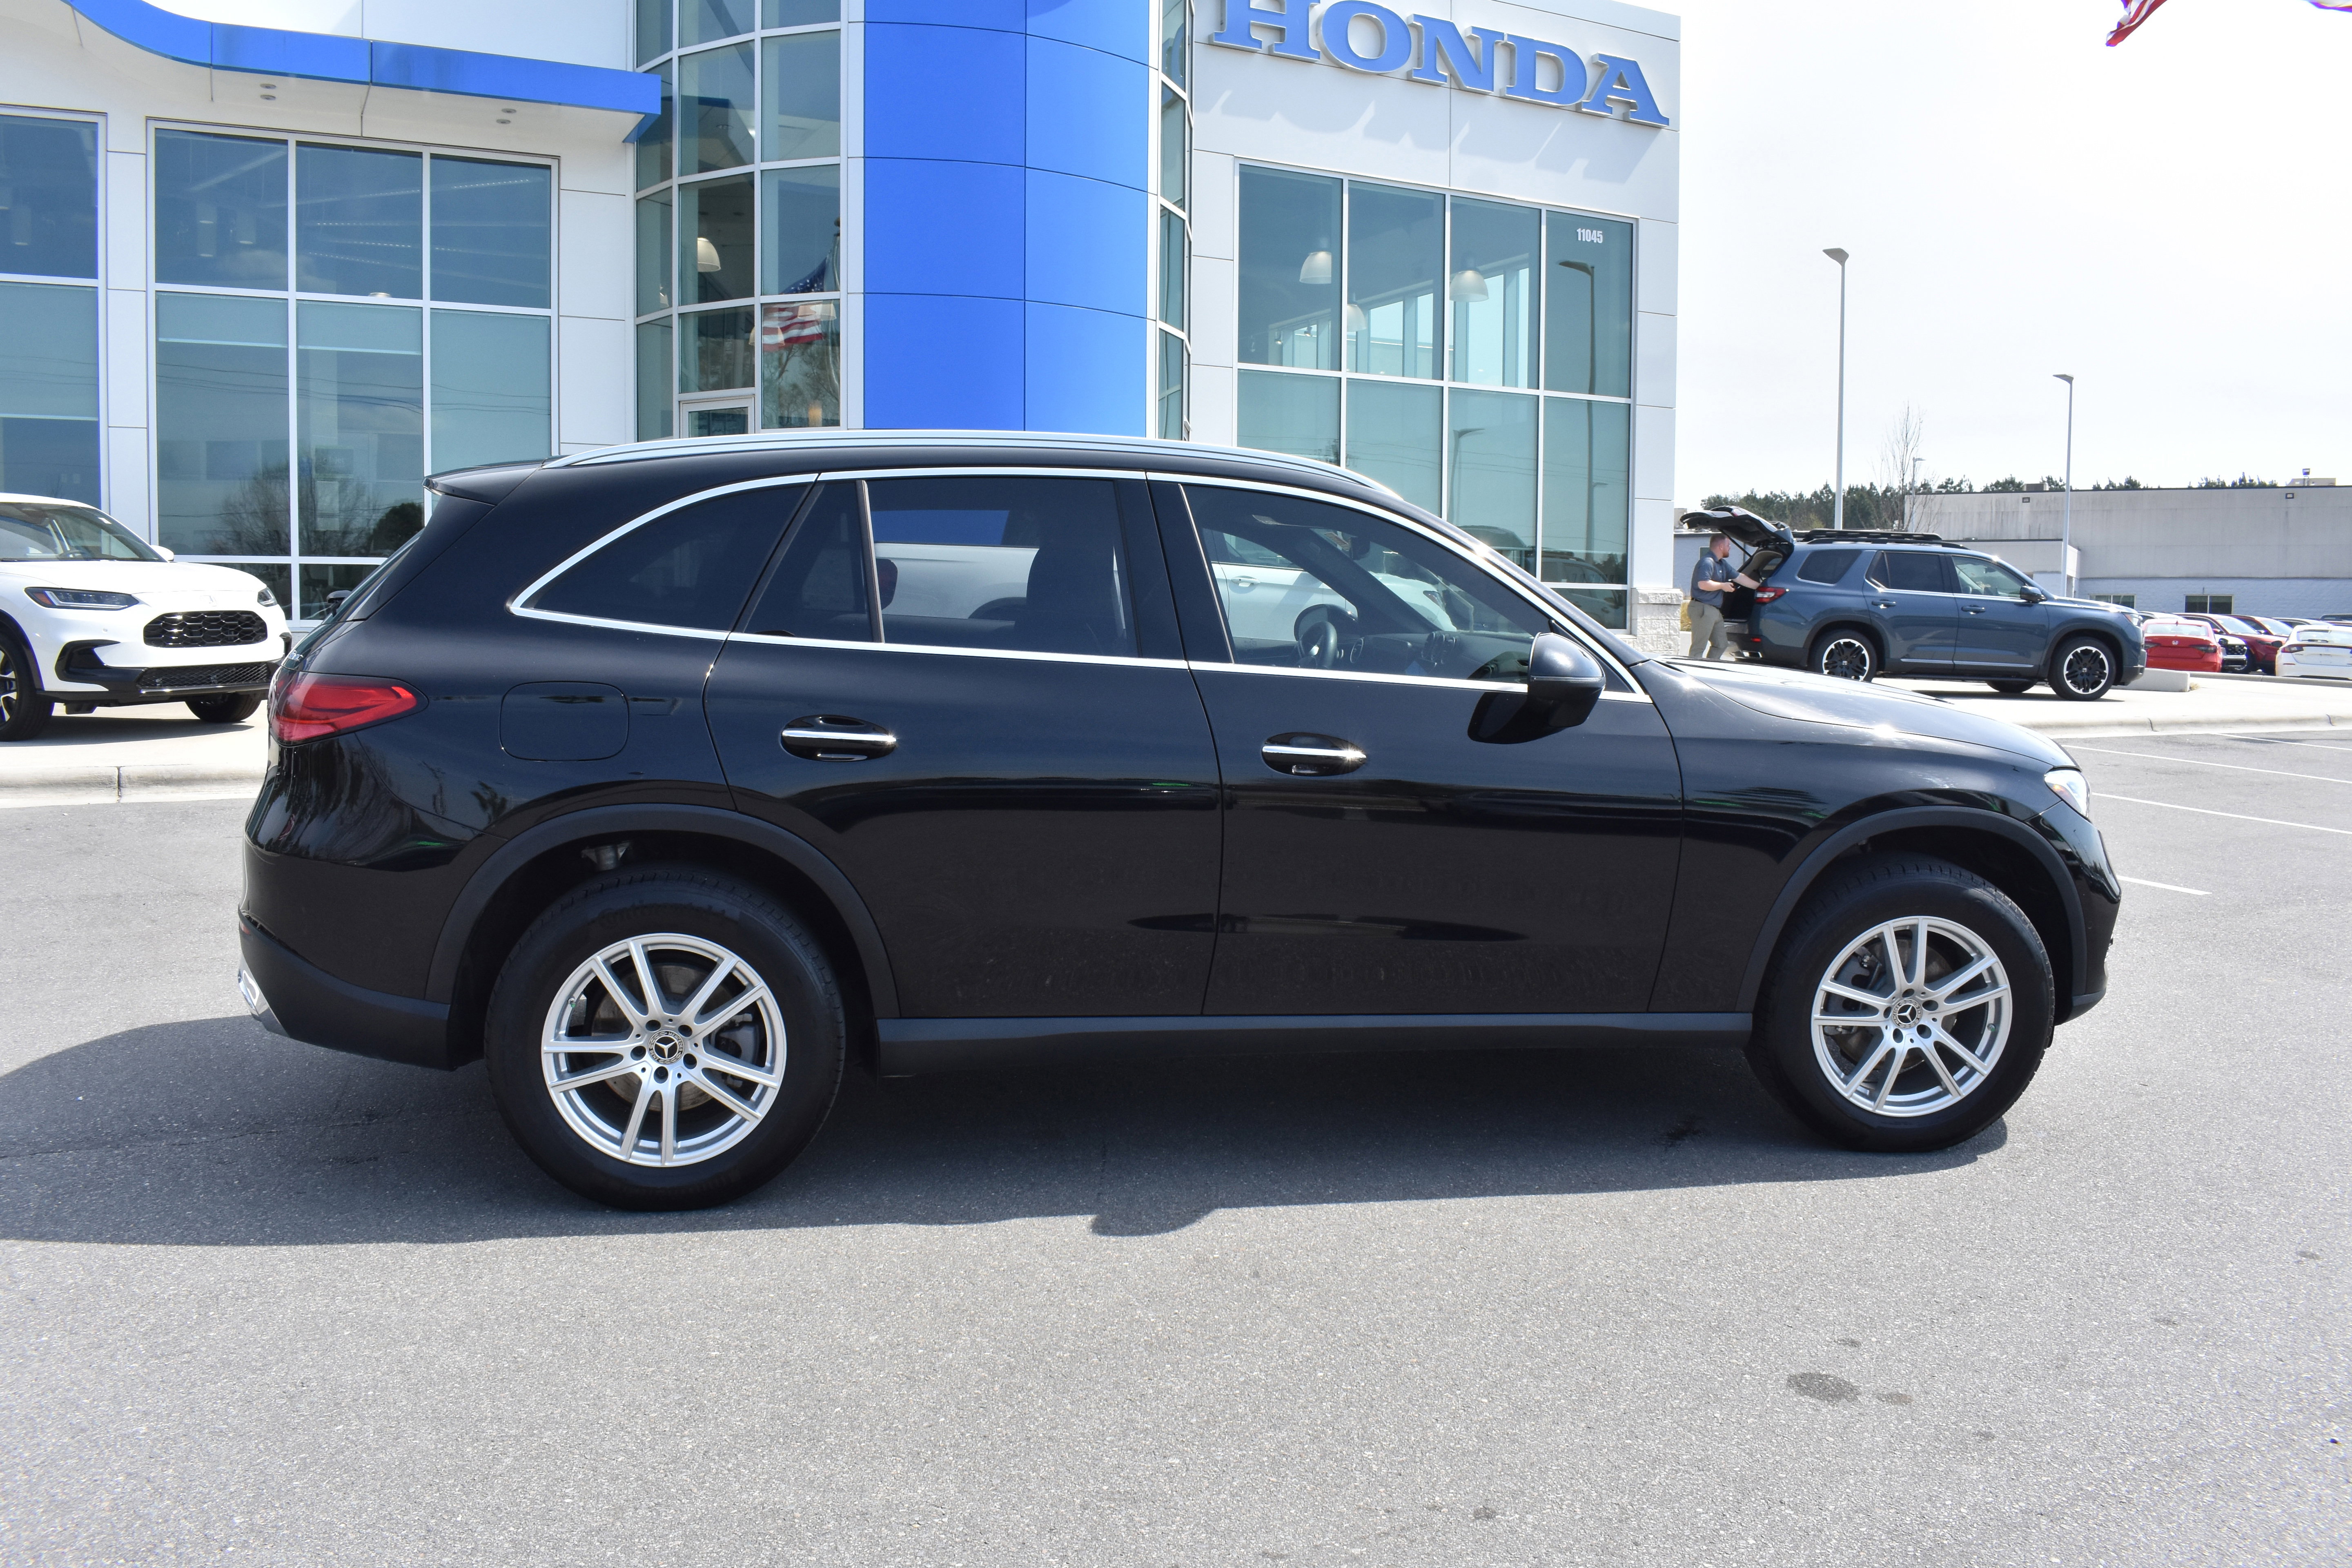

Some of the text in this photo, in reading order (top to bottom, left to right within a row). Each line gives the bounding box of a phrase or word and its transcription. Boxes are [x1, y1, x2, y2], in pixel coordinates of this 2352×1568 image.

[1209, 0, 1670, 126] HONDA
[1577, 228, 1603, 243] 11045
[668, 1031, 683, 1051] MERCEDES
[650, 1050, 659, 1060] BENZ
